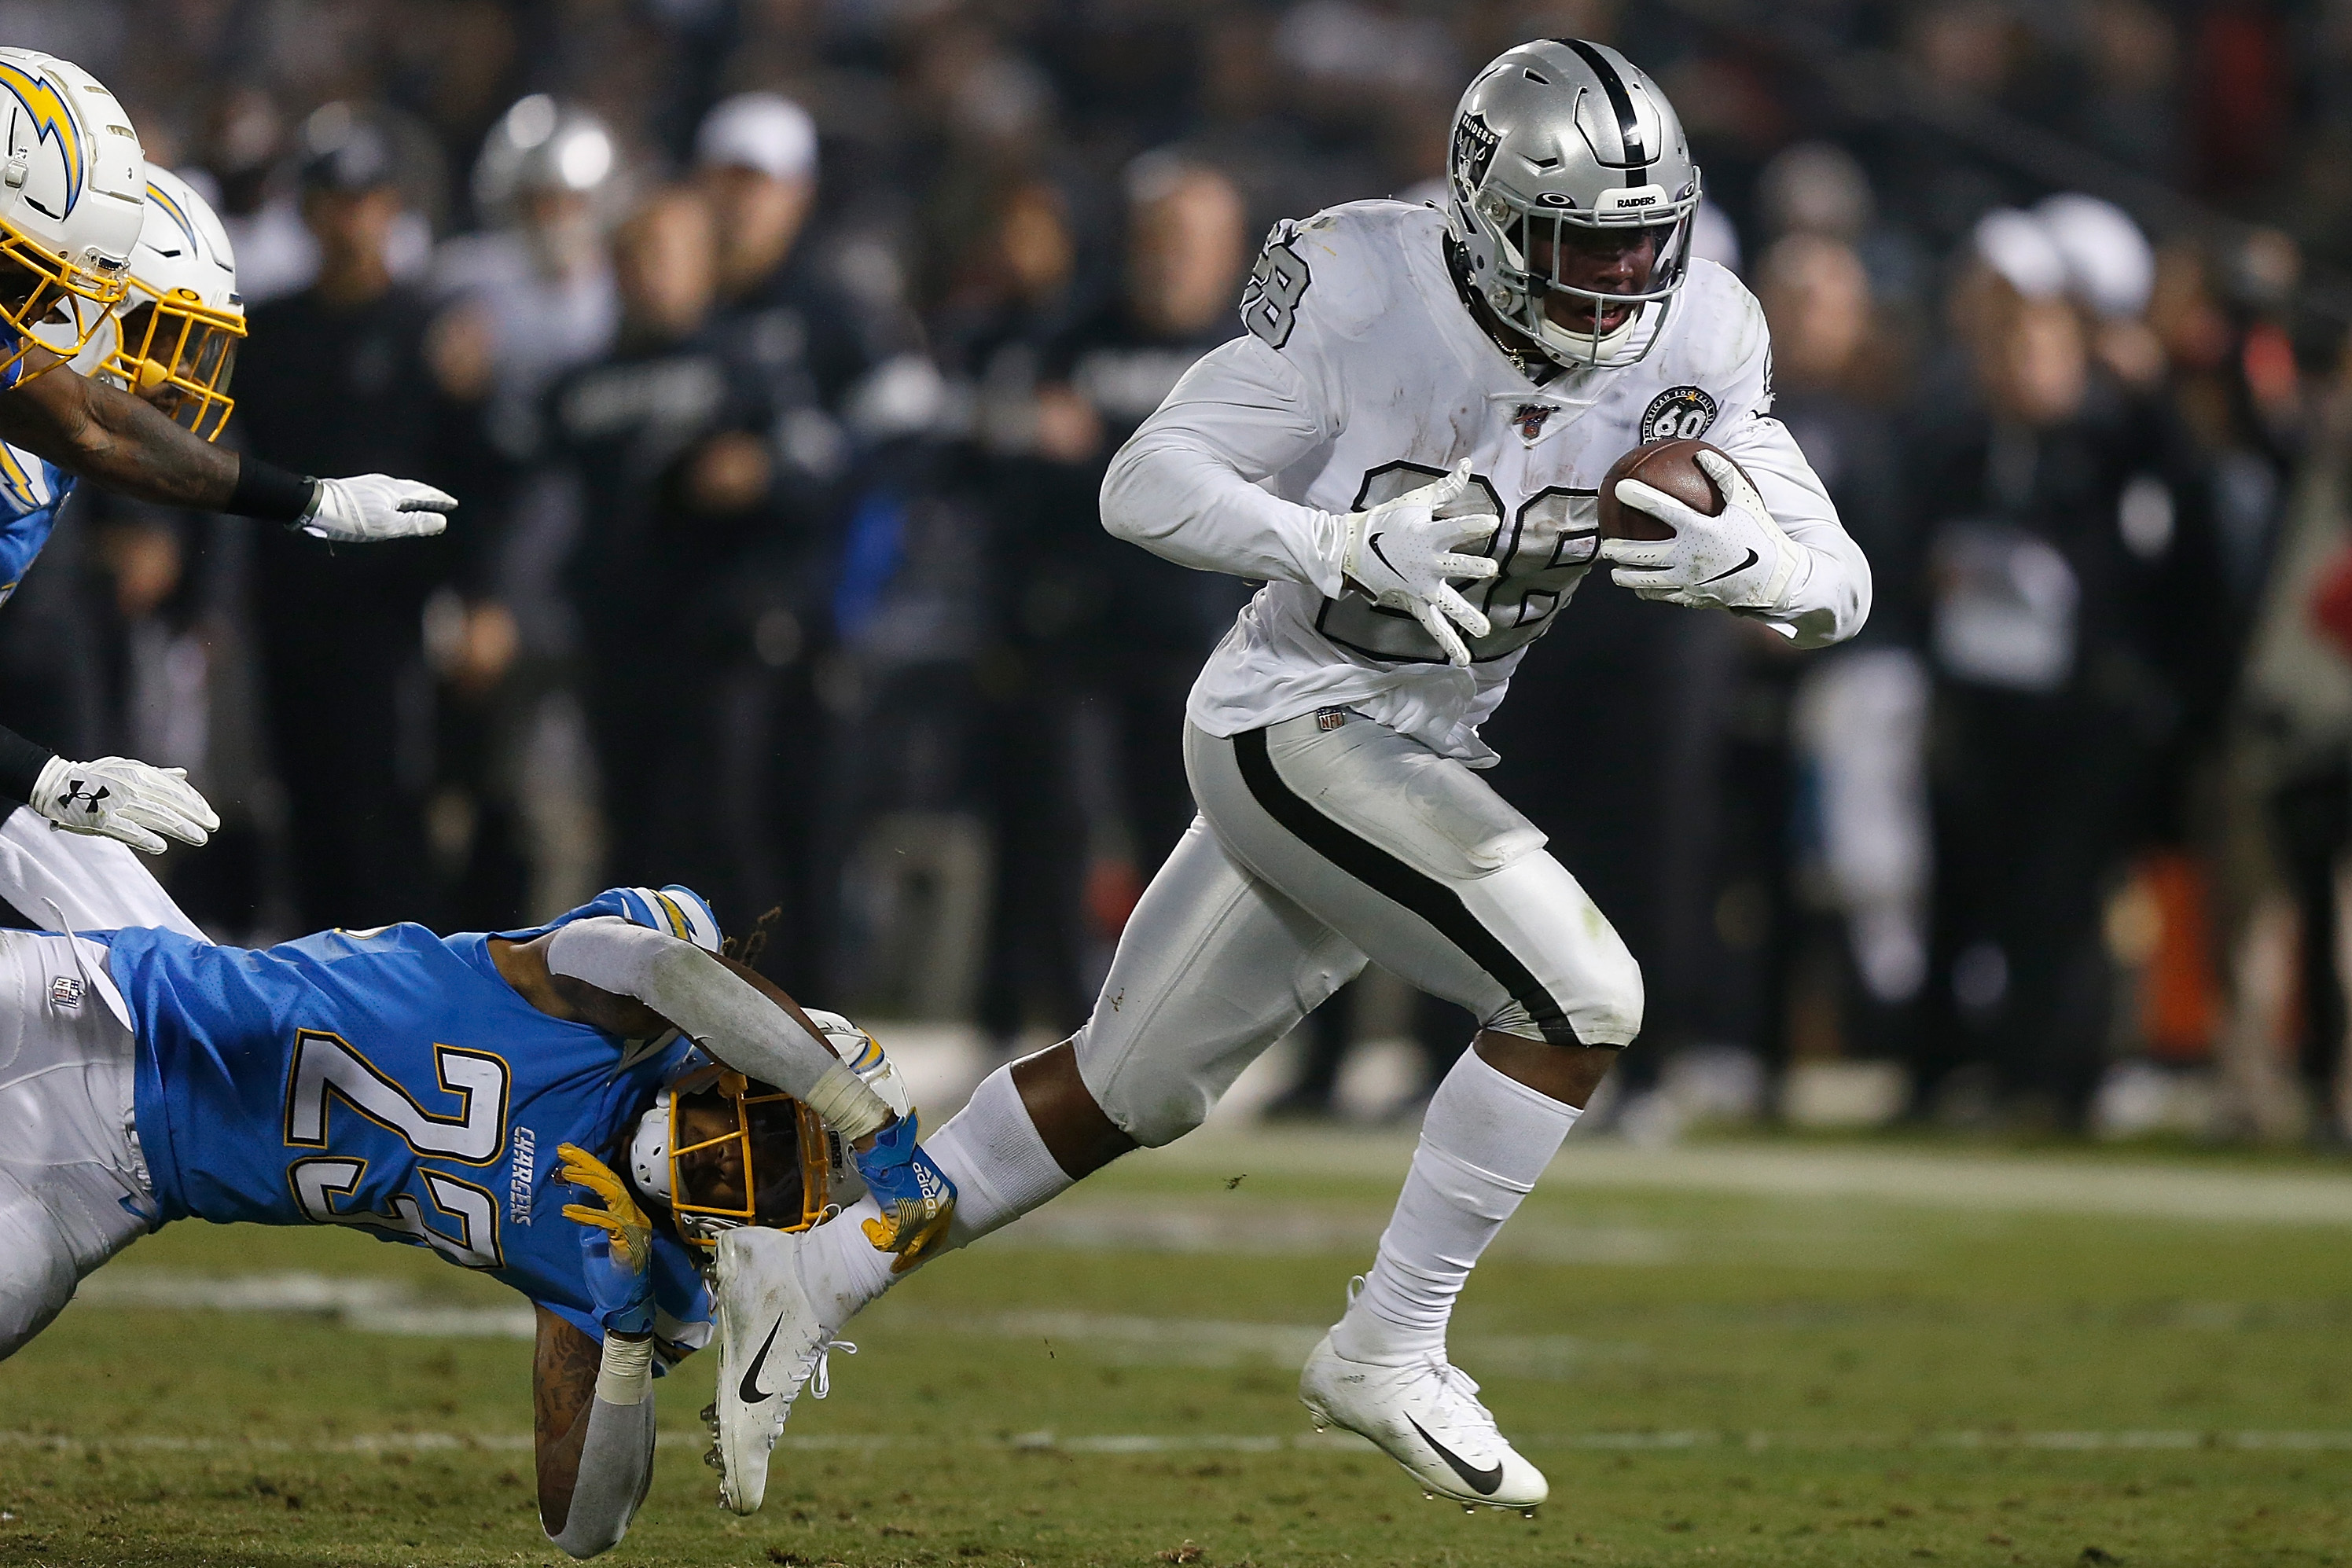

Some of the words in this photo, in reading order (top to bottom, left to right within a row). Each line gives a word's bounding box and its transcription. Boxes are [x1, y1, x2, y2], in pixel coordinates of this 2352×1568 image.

[1461, 114, 1495, 145] RAIDERS
[1617, 196, 1656, 208] RAIDERS
[1644, 394, 1670, 439] AMERICAN
[1653, 406, 1707, 440] 60
[1320, 713, 1343, 729] NFL
[55, 979, 69, 1000] NFL
[284, 1027, 511, 1272] 23
[510, 1126, 535, 1227] CHARGERS
[912, 1162, 936, 1220] adidas
